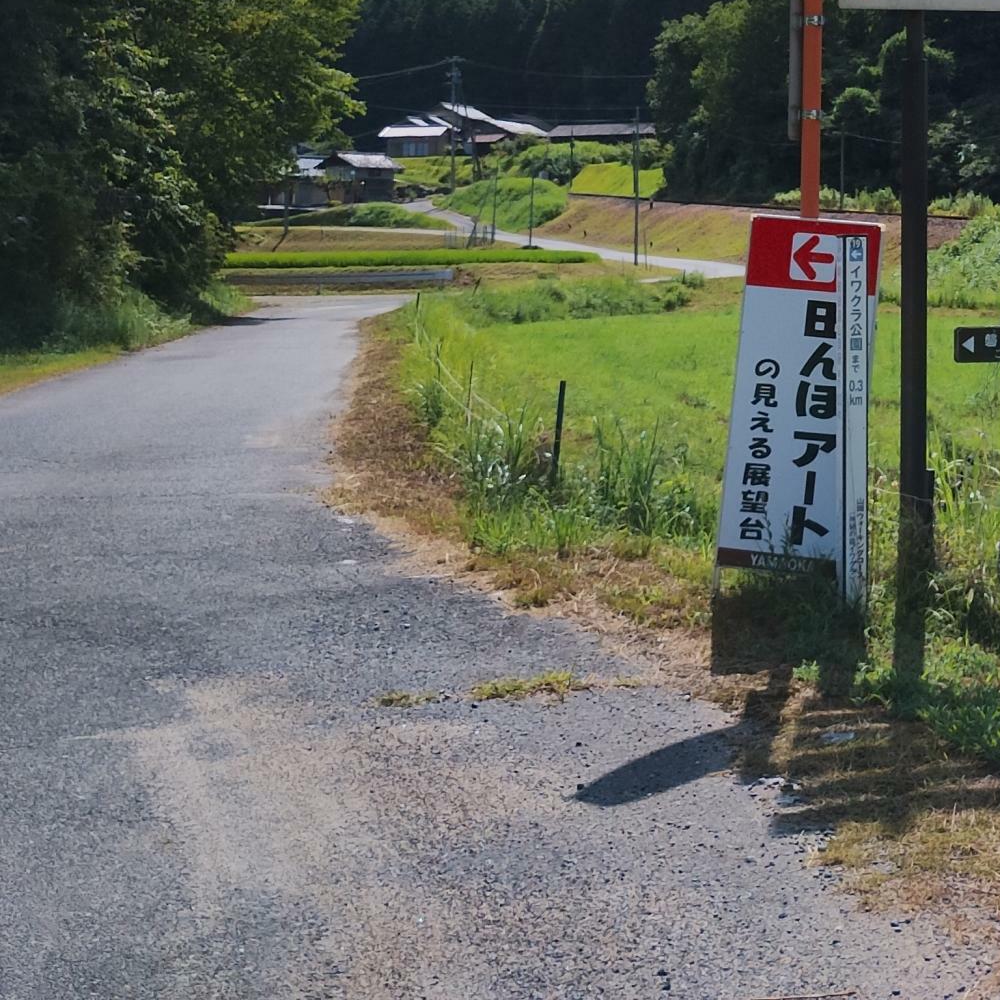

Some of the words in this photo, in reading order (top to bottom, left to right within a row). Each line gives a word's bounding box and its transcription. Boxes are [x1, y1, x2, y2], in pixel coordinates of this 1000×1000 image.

[739, 357, 781, 541] の見える展望台
